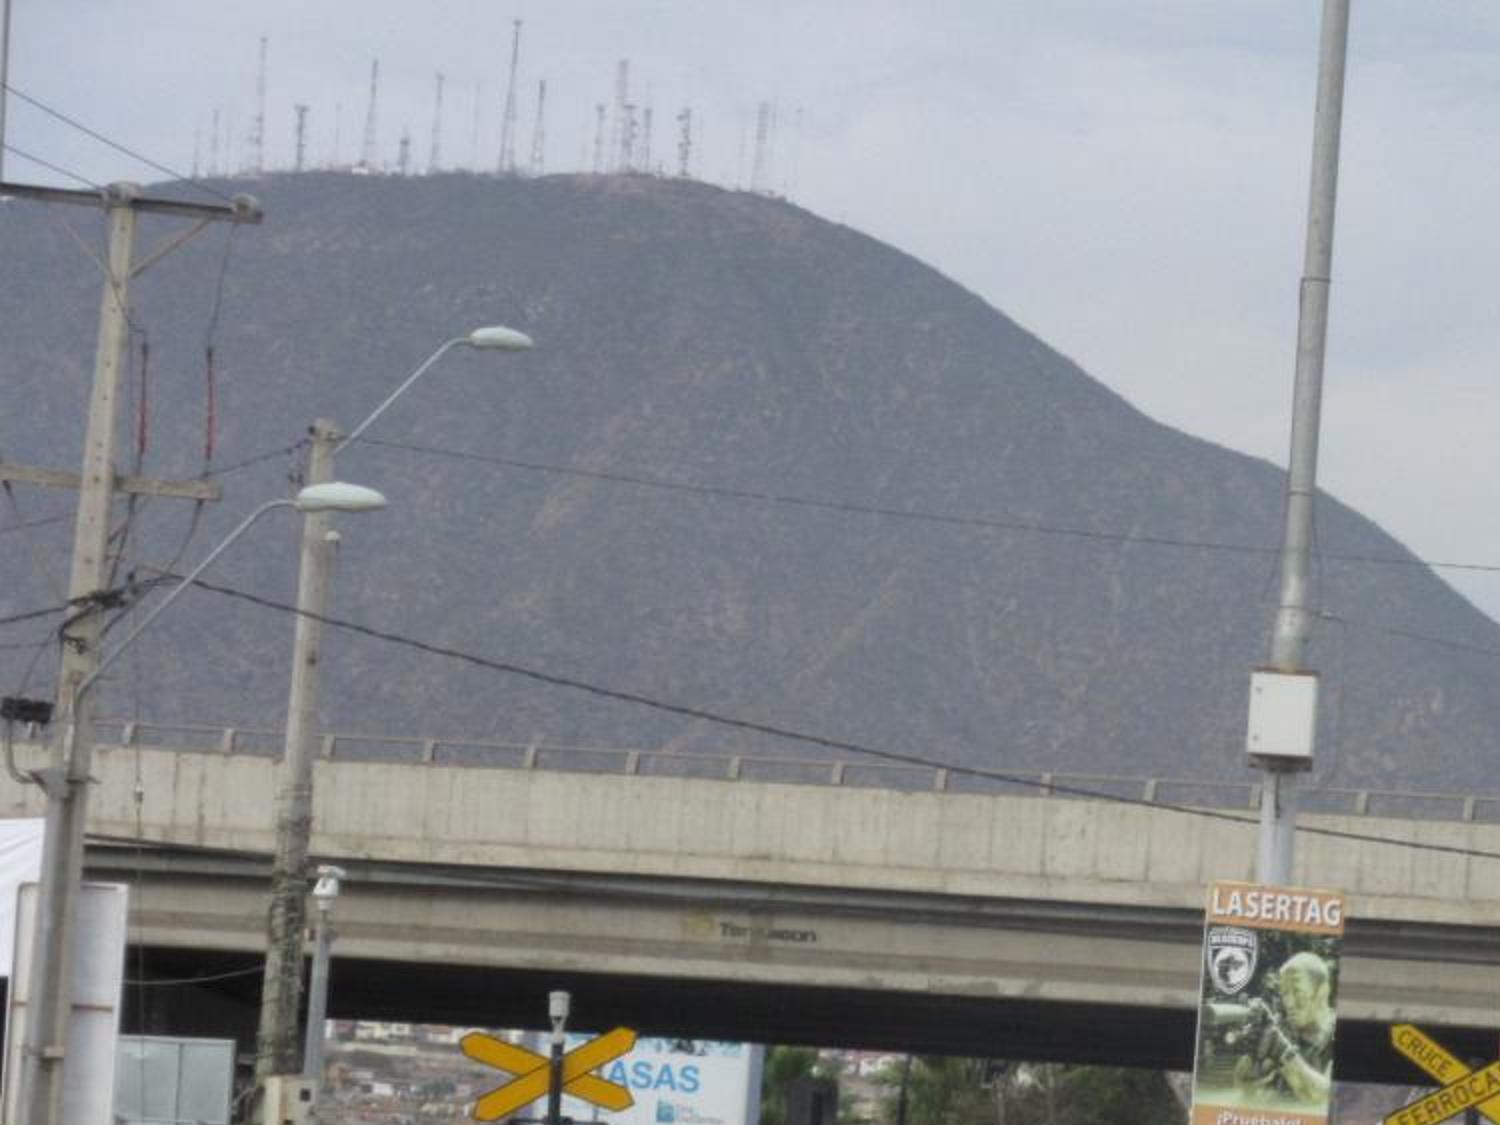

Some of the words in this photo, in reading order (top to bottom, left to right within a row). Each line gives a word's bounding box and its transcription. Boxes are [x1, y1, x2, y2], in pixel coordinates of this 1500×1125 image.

[1213, 887, 1341, 926] LASERTAG
[1400, 1030, 1450, 1078] CRUCE
[606, 1060, 700, 1093] ASAS
